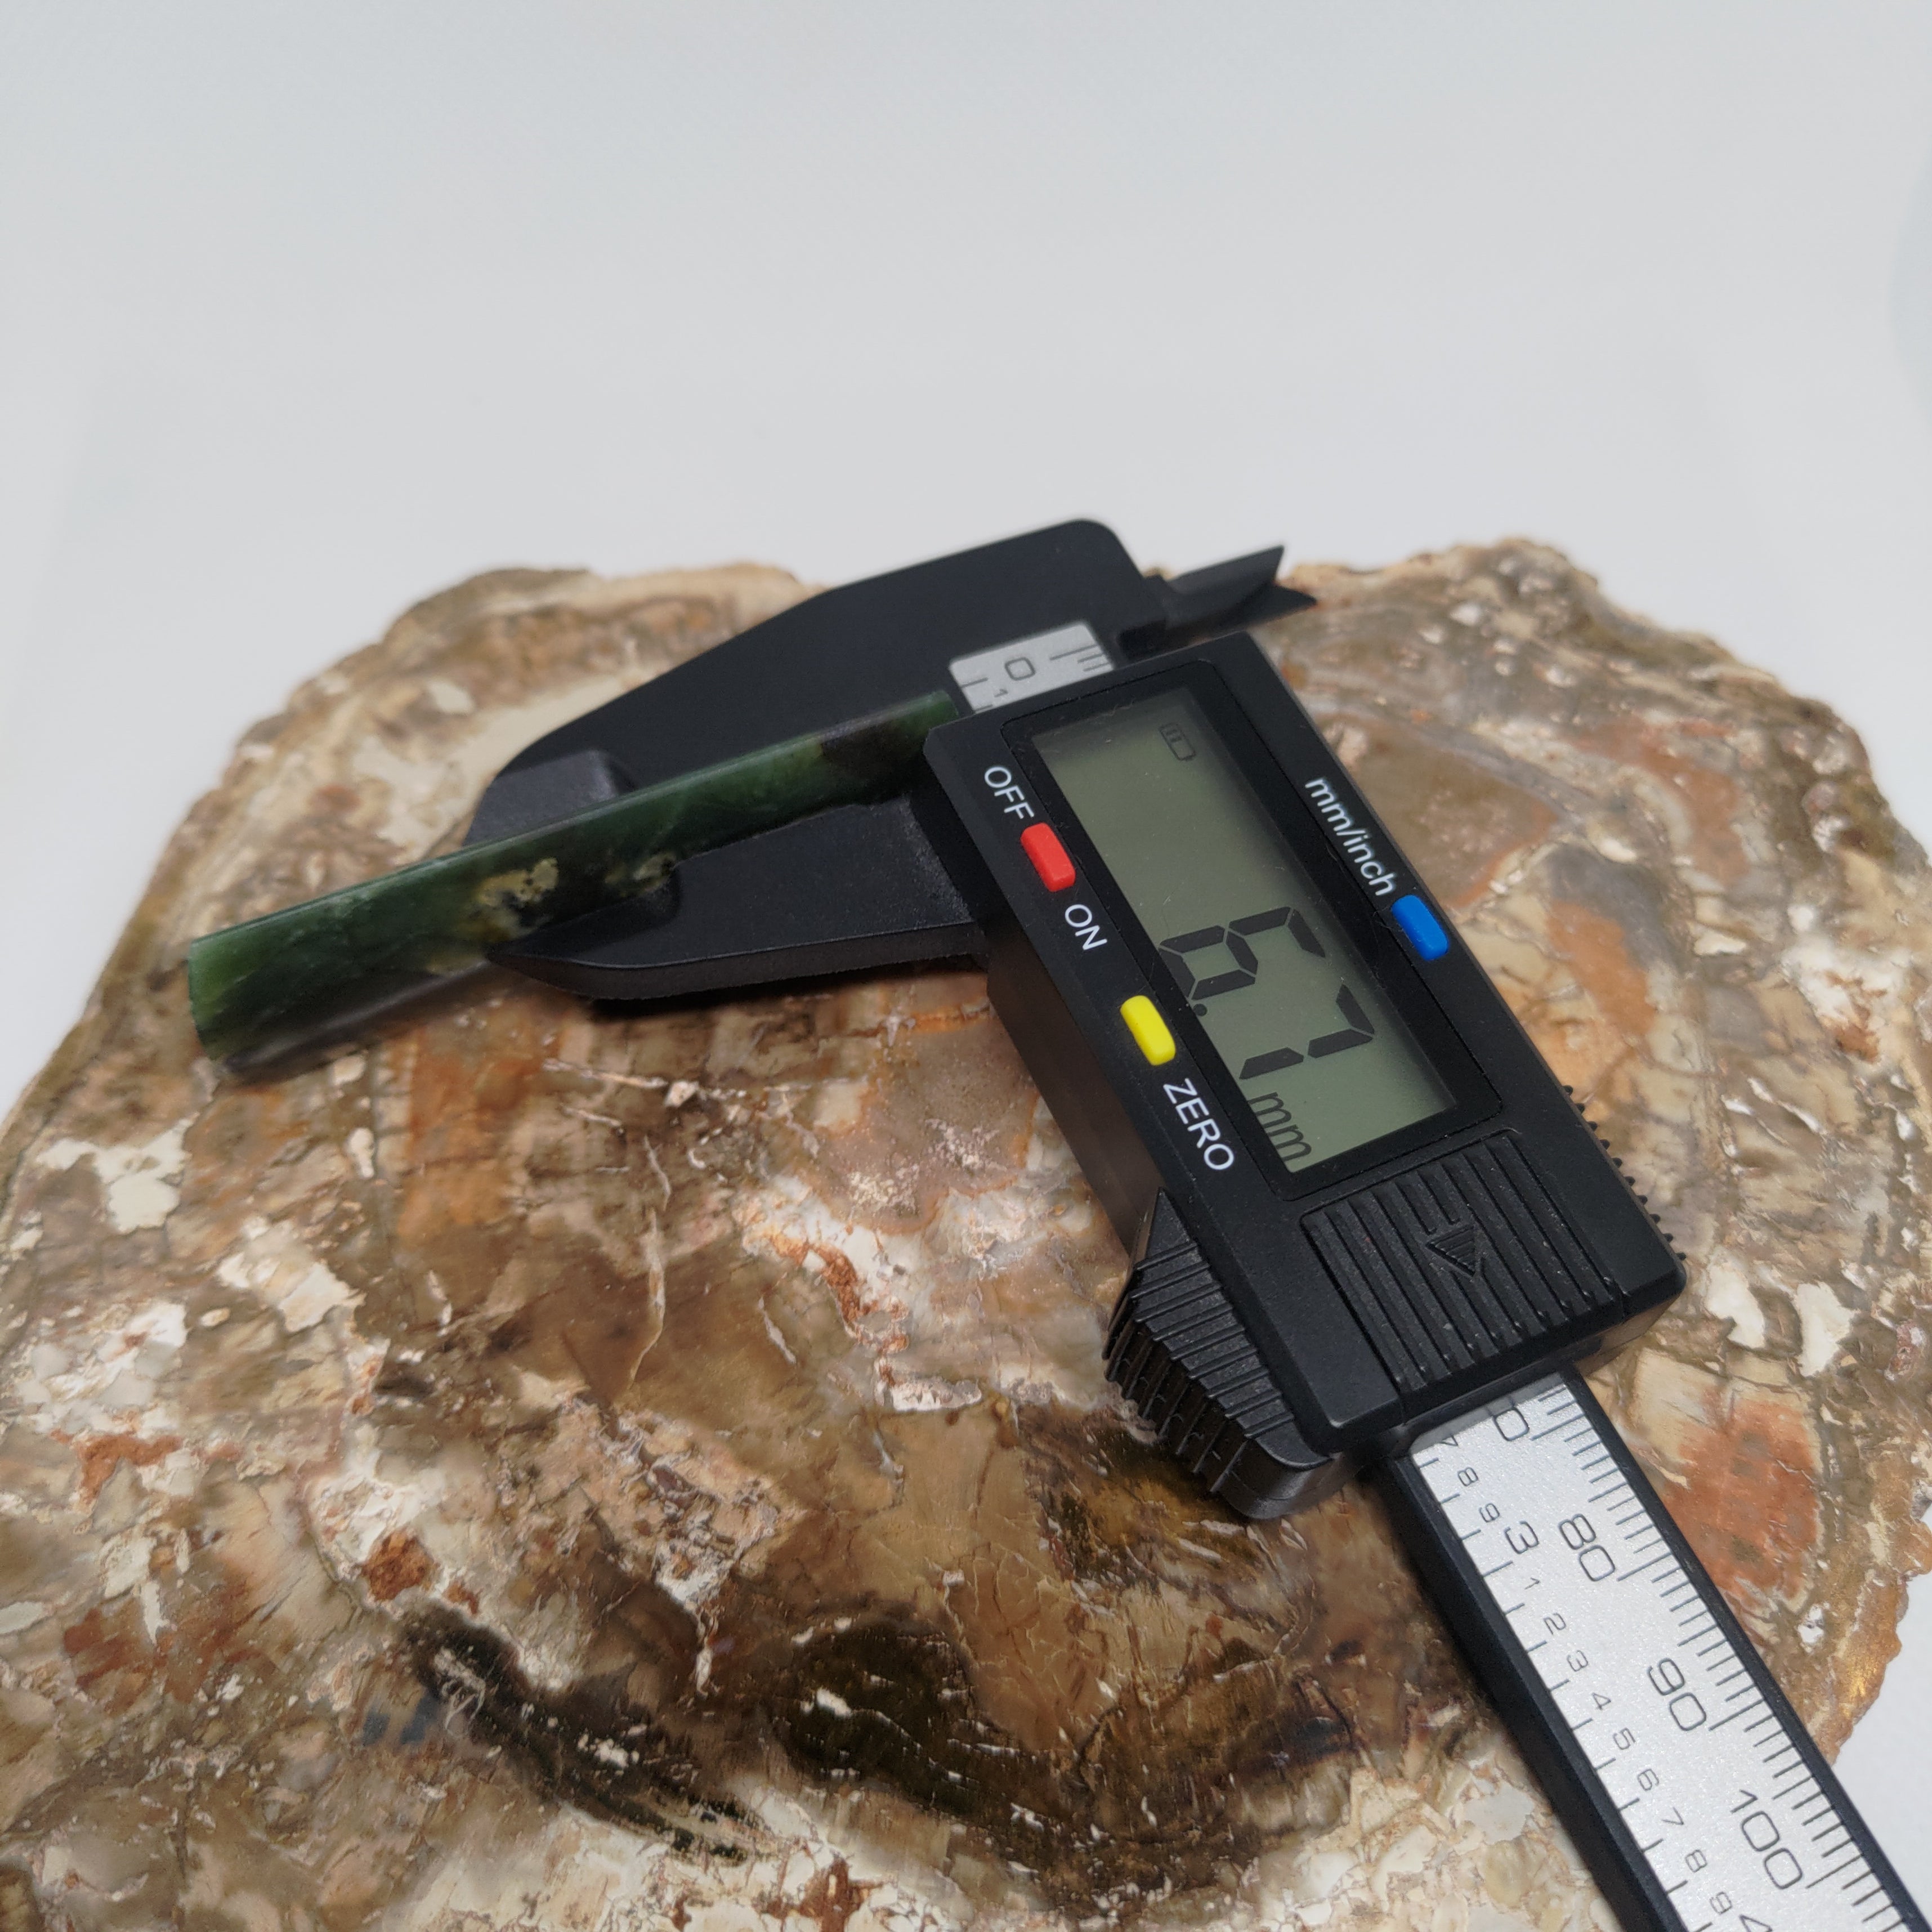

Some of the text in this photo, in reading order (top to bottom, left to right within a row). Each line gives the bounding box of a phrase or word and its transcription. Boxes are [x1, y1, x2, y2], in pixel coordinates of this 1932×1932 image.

[1004, 656, 1036, 681] 0
[984, 766, 1035, 820] OFF
[1304, 777, 1398, 897] mm/inch
[1064, 904, 1108, 951] ON
[1159, 906, 1375, 1163] 6.7 mm
[1162, 1077, 1235, 1171] ZERO
[1457, 1466, 1479, 1487] 8
[1478, 1502, 1501, 1523] 9
[1504, 1520, 1540, 1555] 3
[1557, 1513, 1616, 1582] 80
[1524, 1577, 1540, 1590] 1
[1542, 1612, 1567, 1635] 2
[1566, 1650, 1589, 1672] 3
[1591, 1692, 1612, 1711] 4
[1647, 1657, 1707, 1732] 90
[1612, 1727, 1635, 1751] 5
[1636, 1768, 1660, 1792] 6
[1662, 1807, 1684, 1827] 7
[1730, 1788, 1802, 1889] 100
[1685, 1849, 1707, 1873] 8
[1709, 1891, 1733, 1915] 9
